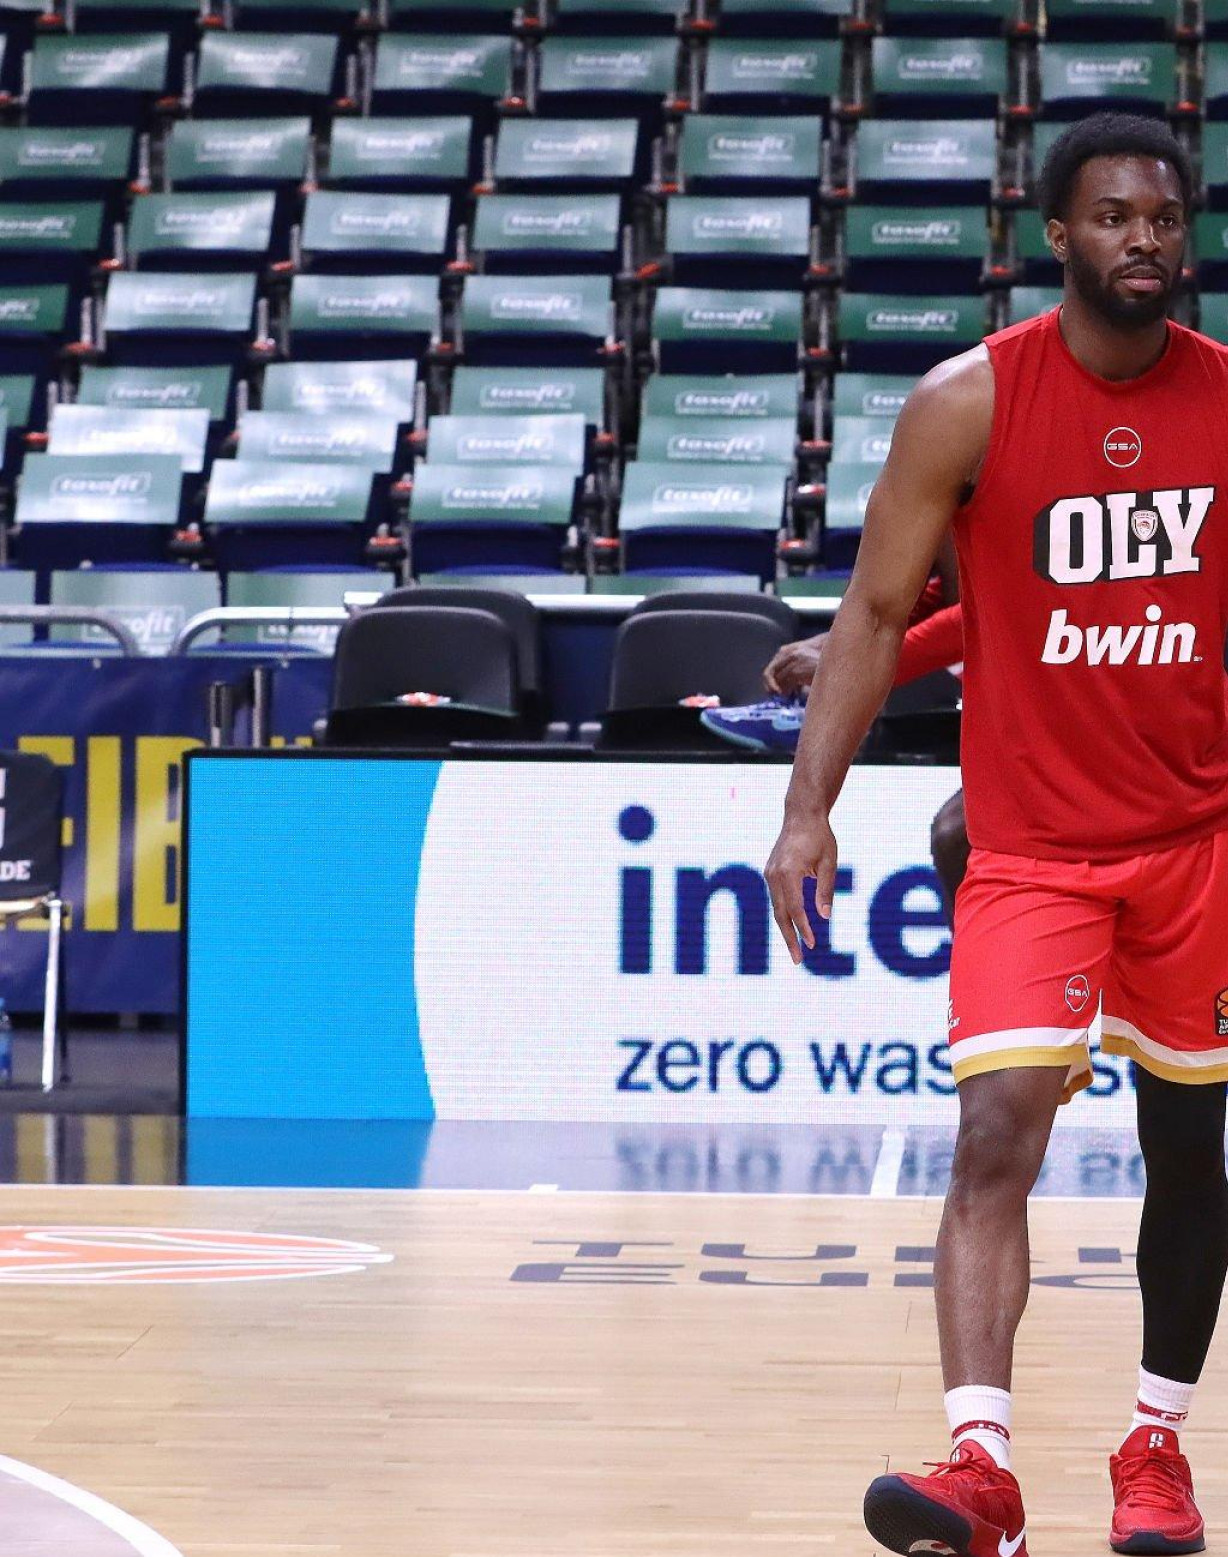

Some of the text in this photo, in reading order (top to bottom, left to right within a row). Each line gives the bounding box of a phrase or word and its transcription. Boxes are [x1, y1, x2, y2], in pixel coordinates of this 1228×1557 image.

[1106, 442, 1139, 451] GSA
[1047, 486, 1215, 585] OLY
[1041, 604, 1197, 666] bwin
[616, 1037, 784, 1093] zero
[809, 1038, 958, 1095] was
